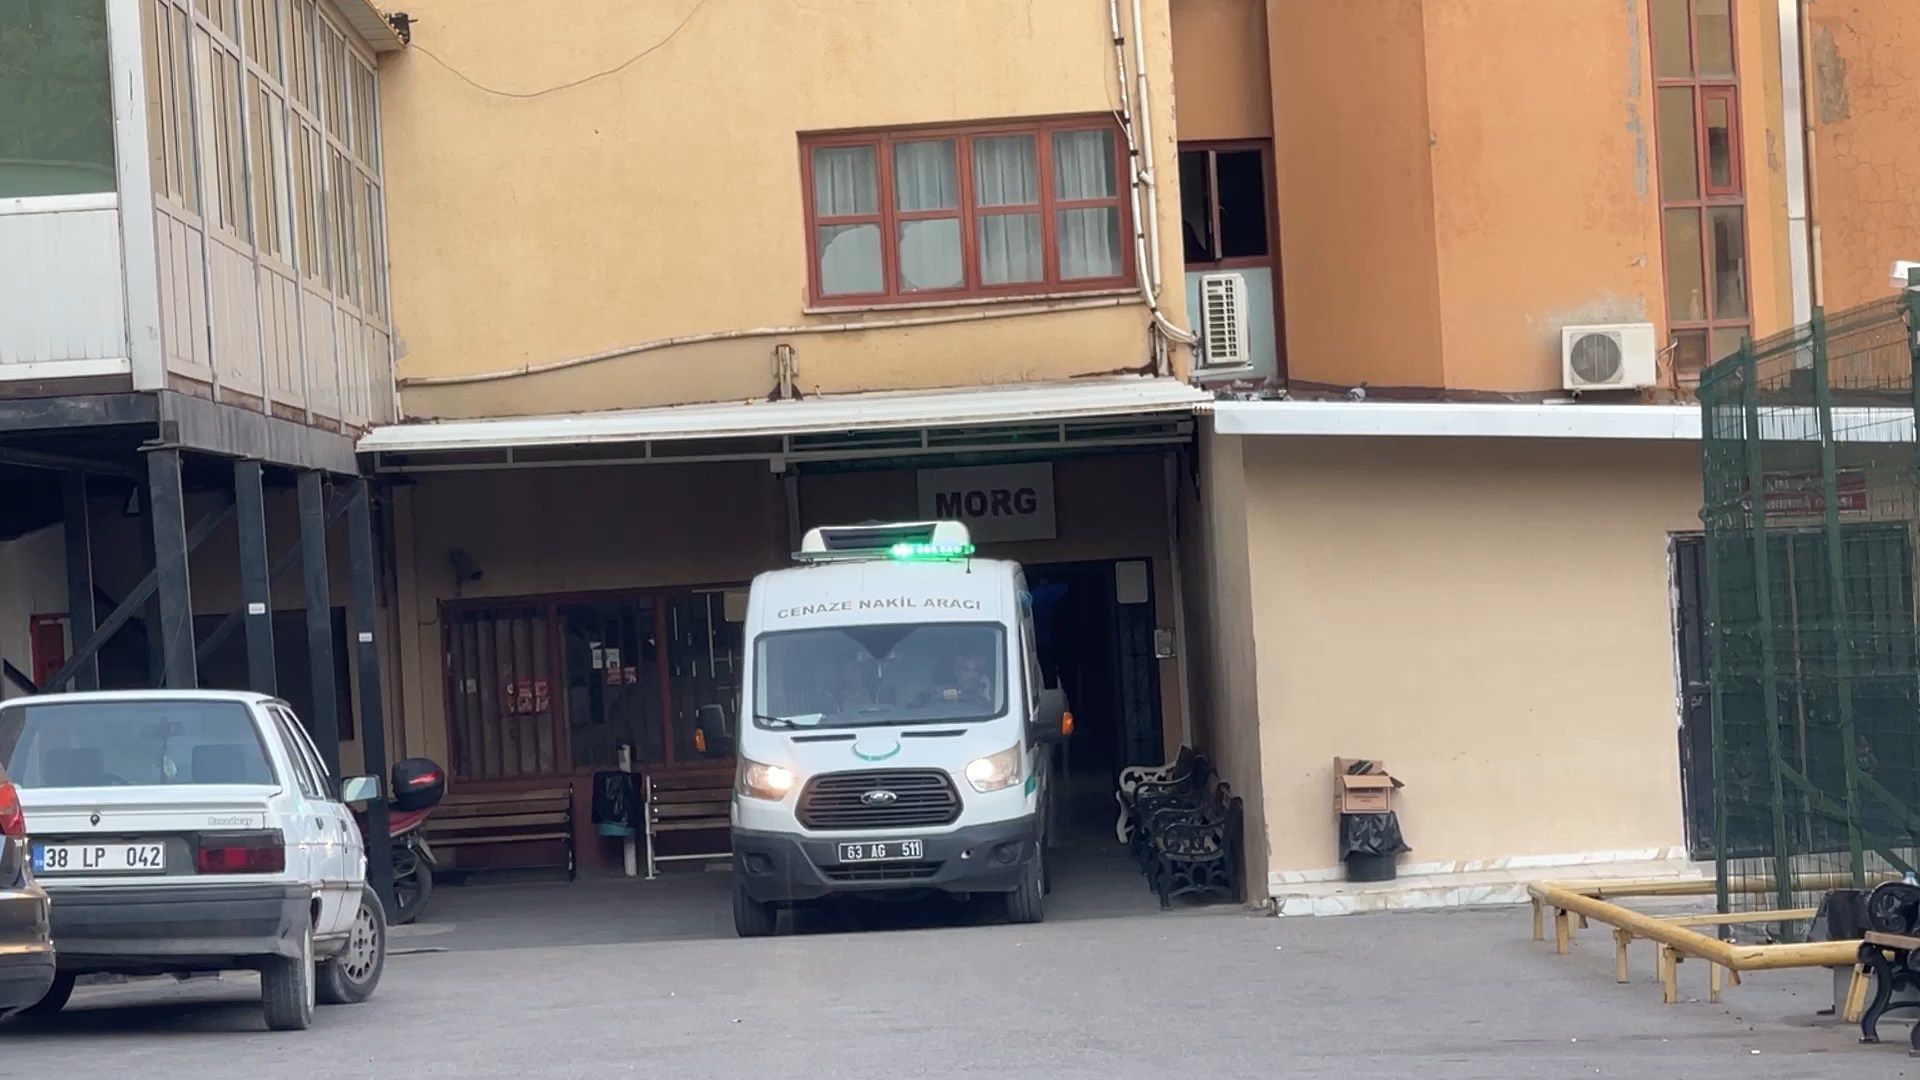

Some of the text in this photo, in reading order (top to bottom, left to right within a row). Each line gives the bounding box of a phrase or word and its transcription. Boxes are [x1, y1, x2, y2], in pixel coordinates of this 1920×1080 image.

[935, 487, 1037, 518] MORG
[777, 596, 981, 619] CENAZE NAKİL ARACI
[46, 846, 161, 868] 38 LP 042
[847, 841, 920, 859] 63 AG 511
